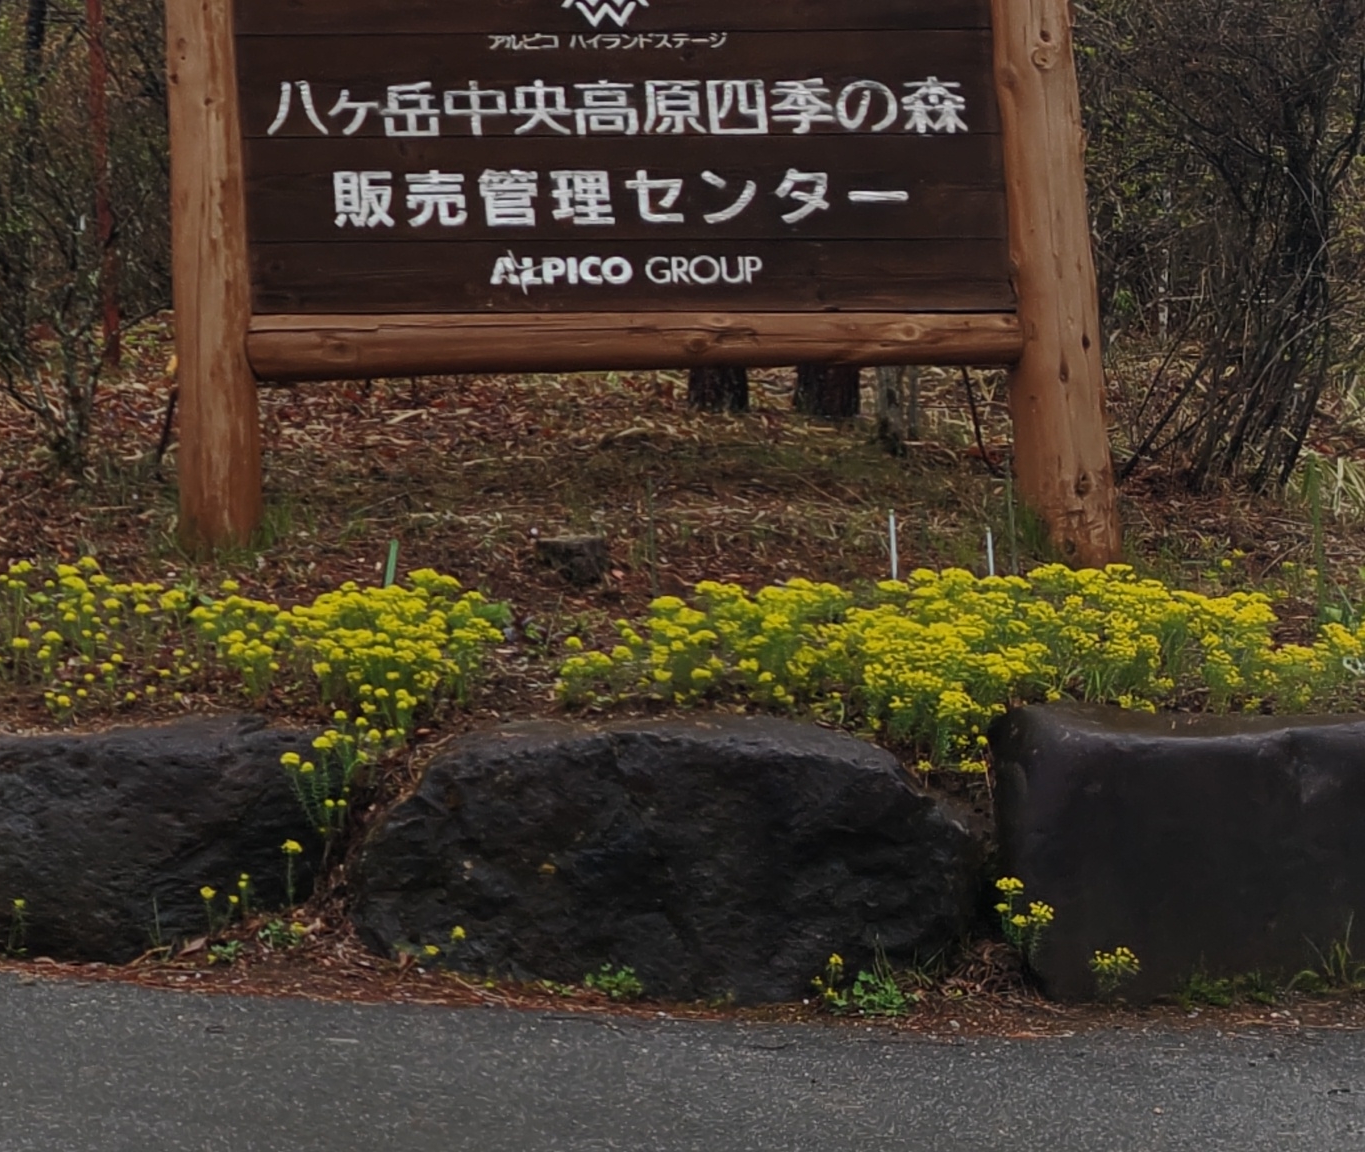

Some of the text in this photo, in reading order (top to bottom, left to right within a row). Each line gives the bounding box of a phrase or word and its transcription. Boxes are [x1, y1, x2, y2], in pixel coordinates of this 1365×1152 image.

[569, 32, 728, 50] ハイランドステージ
[332, 168, 909, 228] 販売管理センター
[490, 250, 763, 295] ALPICO GROUP
